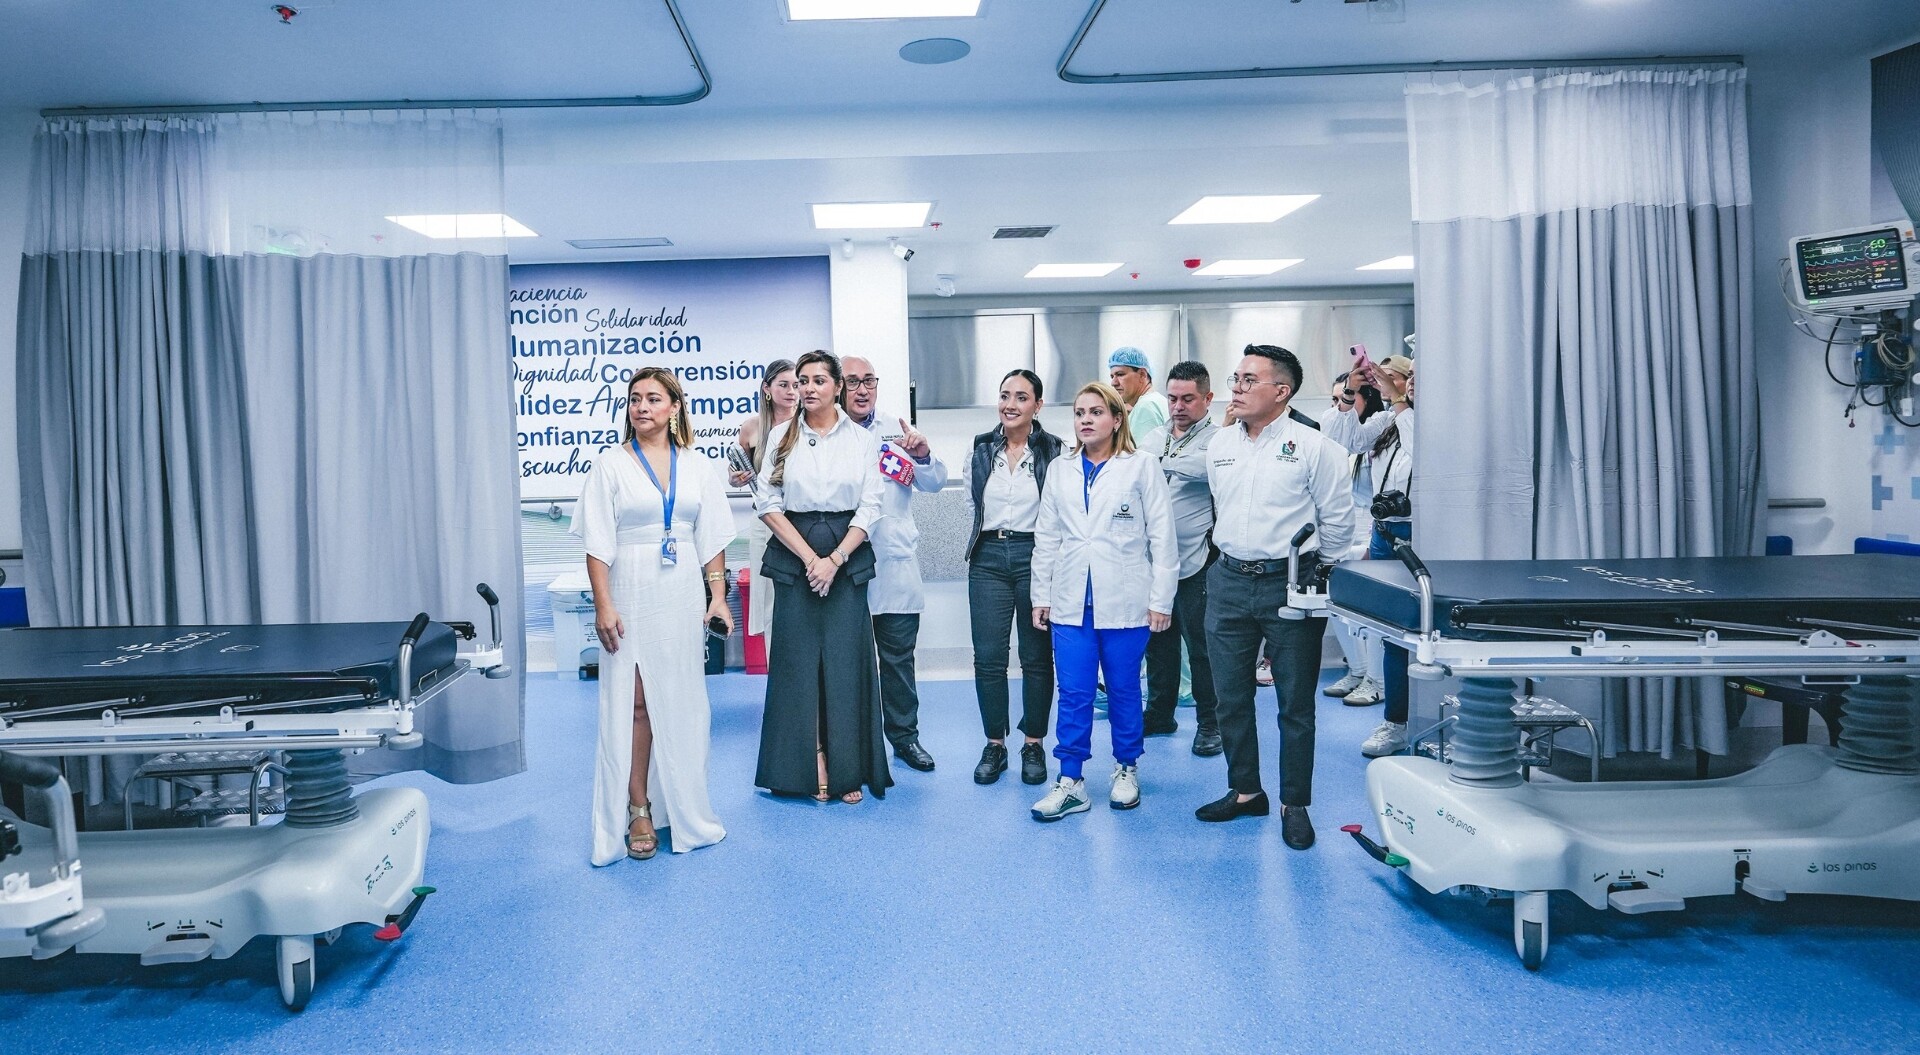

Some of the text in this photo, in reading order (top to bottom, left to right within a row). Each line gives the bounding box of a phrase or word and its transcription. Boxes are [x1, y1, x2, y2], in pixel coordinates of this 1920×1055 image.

[1821, 246, 1844, 254] DEMO
[584, 306, 688, 332] Solidaridad
[601, 360, 765, 384] Corensión
[515, 394, 582, 416] lidez
[684, 391, 759, 420] mpat
[518, 447, 592, 478] scucha
[1445, 811, 1477, 836] los pinos
[1823, 862, 1877, 873] los pinos
